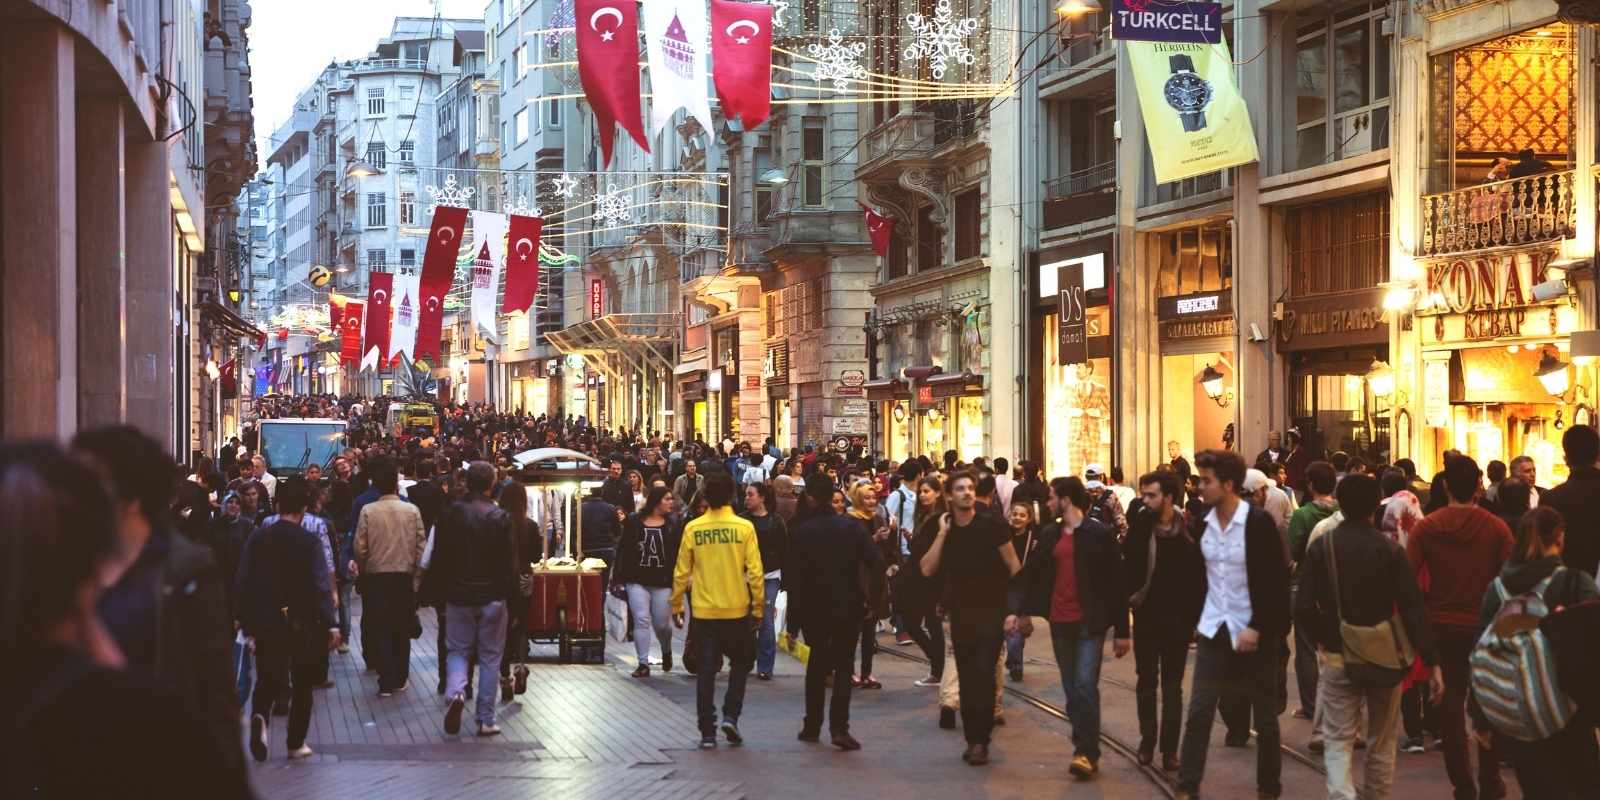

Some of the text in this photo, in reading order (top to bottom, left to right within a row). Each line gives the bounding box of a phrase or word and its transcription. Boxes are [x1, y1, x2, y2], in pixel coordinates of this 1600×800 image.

[1118, 10, 1215, 32] TURKCELL
[1422, 248, 1560, 313] KONAK
[1061, 286, 1082, 323] D'S
[1464, 310, 1526, 339] KEBAP
[640, 528, 665, 567] A
[694, 528, 743, 546] BRASIL
